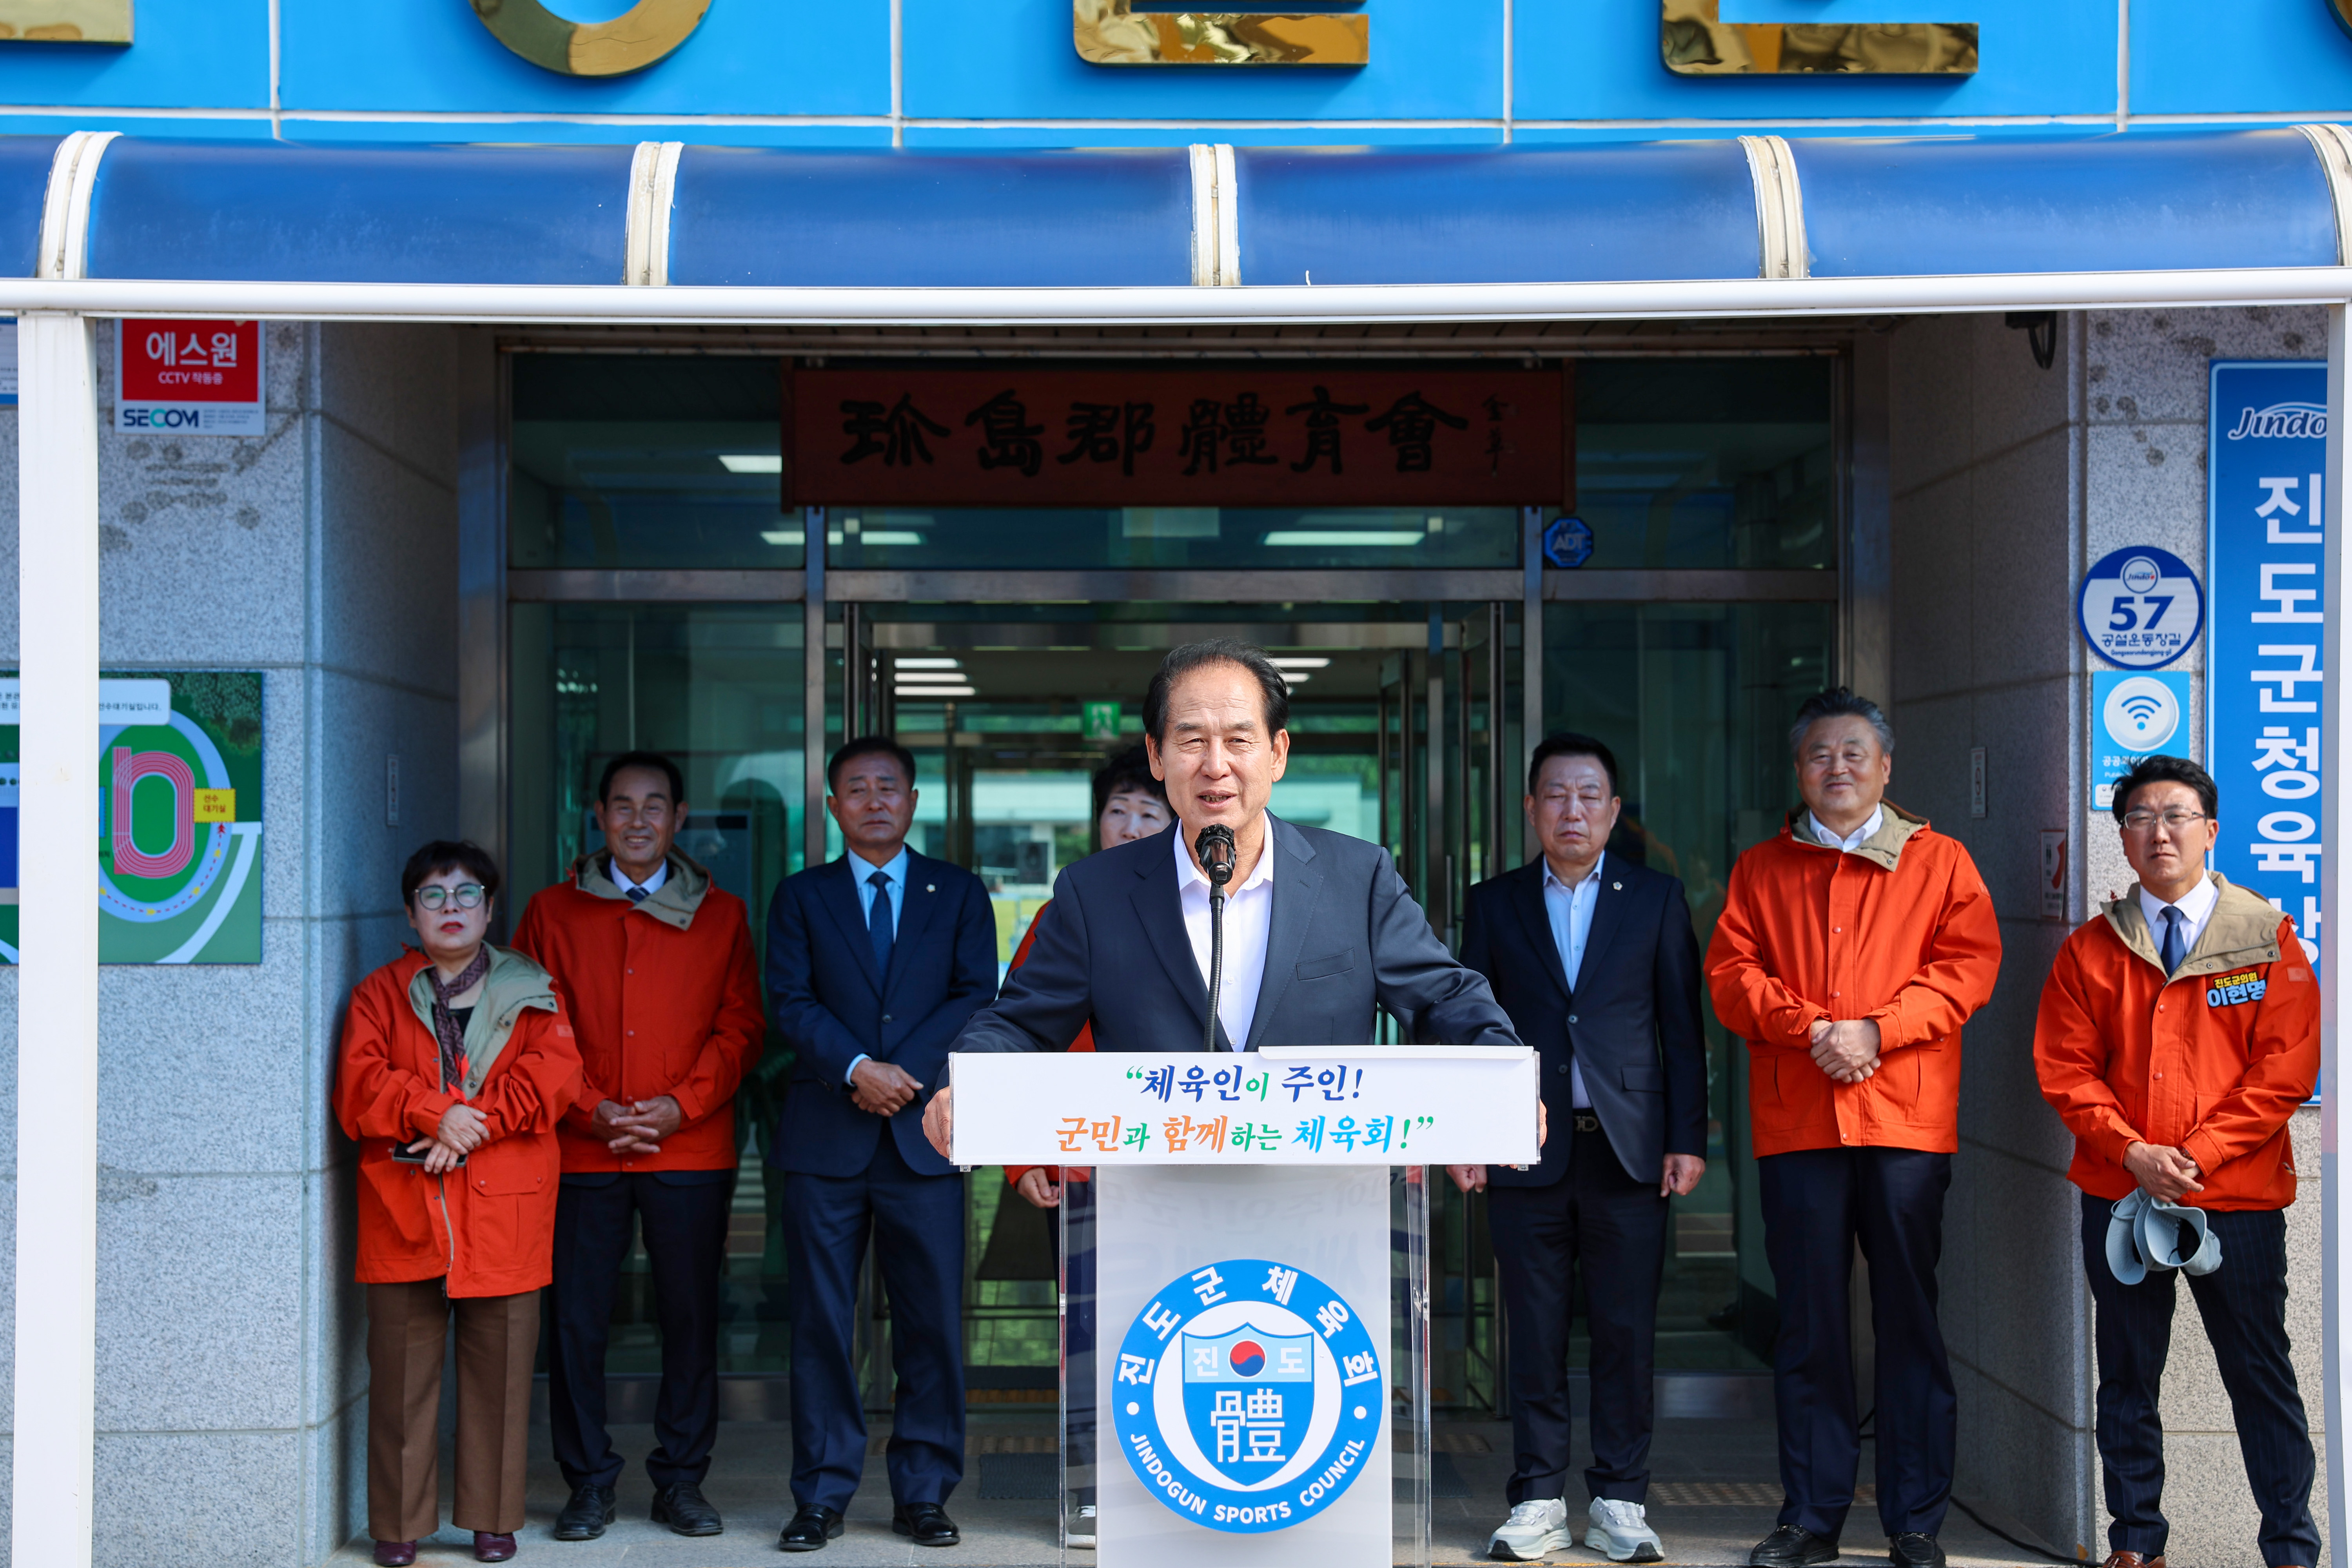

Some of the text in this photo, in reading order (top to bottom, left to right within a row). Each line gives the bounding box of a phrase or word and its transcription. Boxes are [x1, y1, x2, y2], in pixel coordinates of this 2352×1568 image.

[146, 332, 237, 367] 에스원
[158, 371, 190, 384] CCTV
[123, 408, 199, 428] SECOM
[2228, 407, 2327, 440] Jindo
[1552, 534, 1586, 551] ADT
[2109, 596, 2174, 631] 57
[2102, 633, 2180, 647] 공설운동장길
[2207, 979, 2266, 1007] 이현명
[2214, 972, 2258, 989] 진도군의원
[1281, 1065, 1363, 1103] 주인!
[1056, 1115, 1150, 1152] 군민과
[1162, 1115, 1282, 1153] 함께하는
[1118, 1266, 1378, 1387] 진도군체육회
[1193, 1347, 1305, 1377] 진 도
[1211, 1388, 1286, 1463] 體
[1131, 1434, 1365, 1524] JINDOGUN SPORTS COUNCIL
